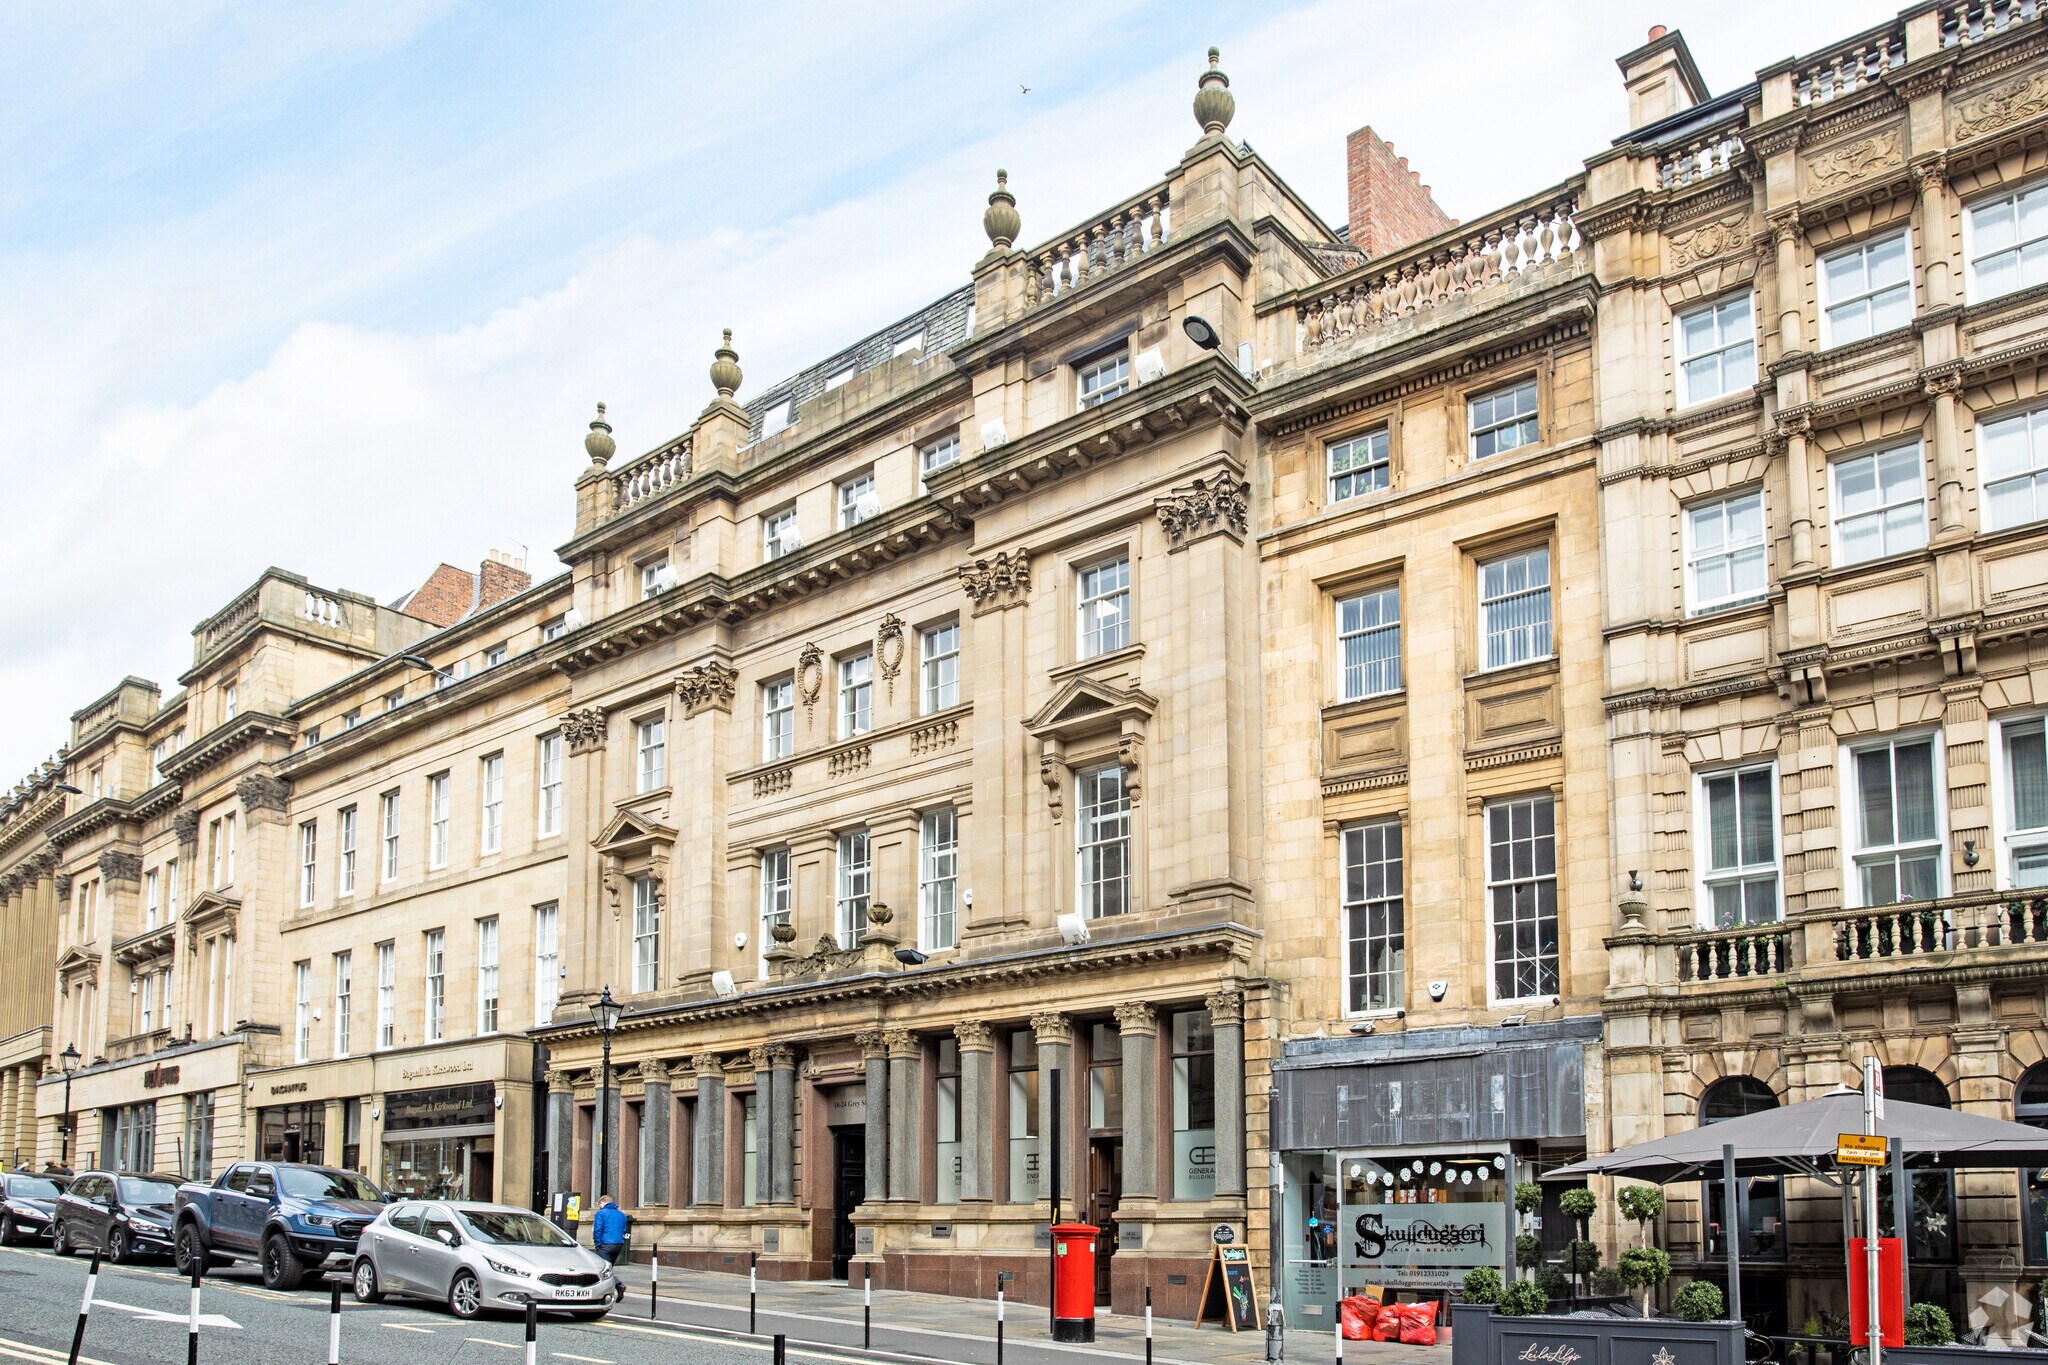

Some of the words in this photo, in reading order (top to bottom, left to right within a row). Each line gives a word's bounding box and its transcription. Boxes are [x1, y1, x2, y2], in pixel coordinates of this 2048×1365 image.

[406, 1103, 427, 1116] Bagnall
[427, 1103, 433, 1112] &
[434, 1101, 461, 1112] Kirkwood
[1355, 1213, 1487, 1259] Skullduggeri
[555, 1289, 575, 1297] RK63
[576, 1289, 590, 1297] WXH
